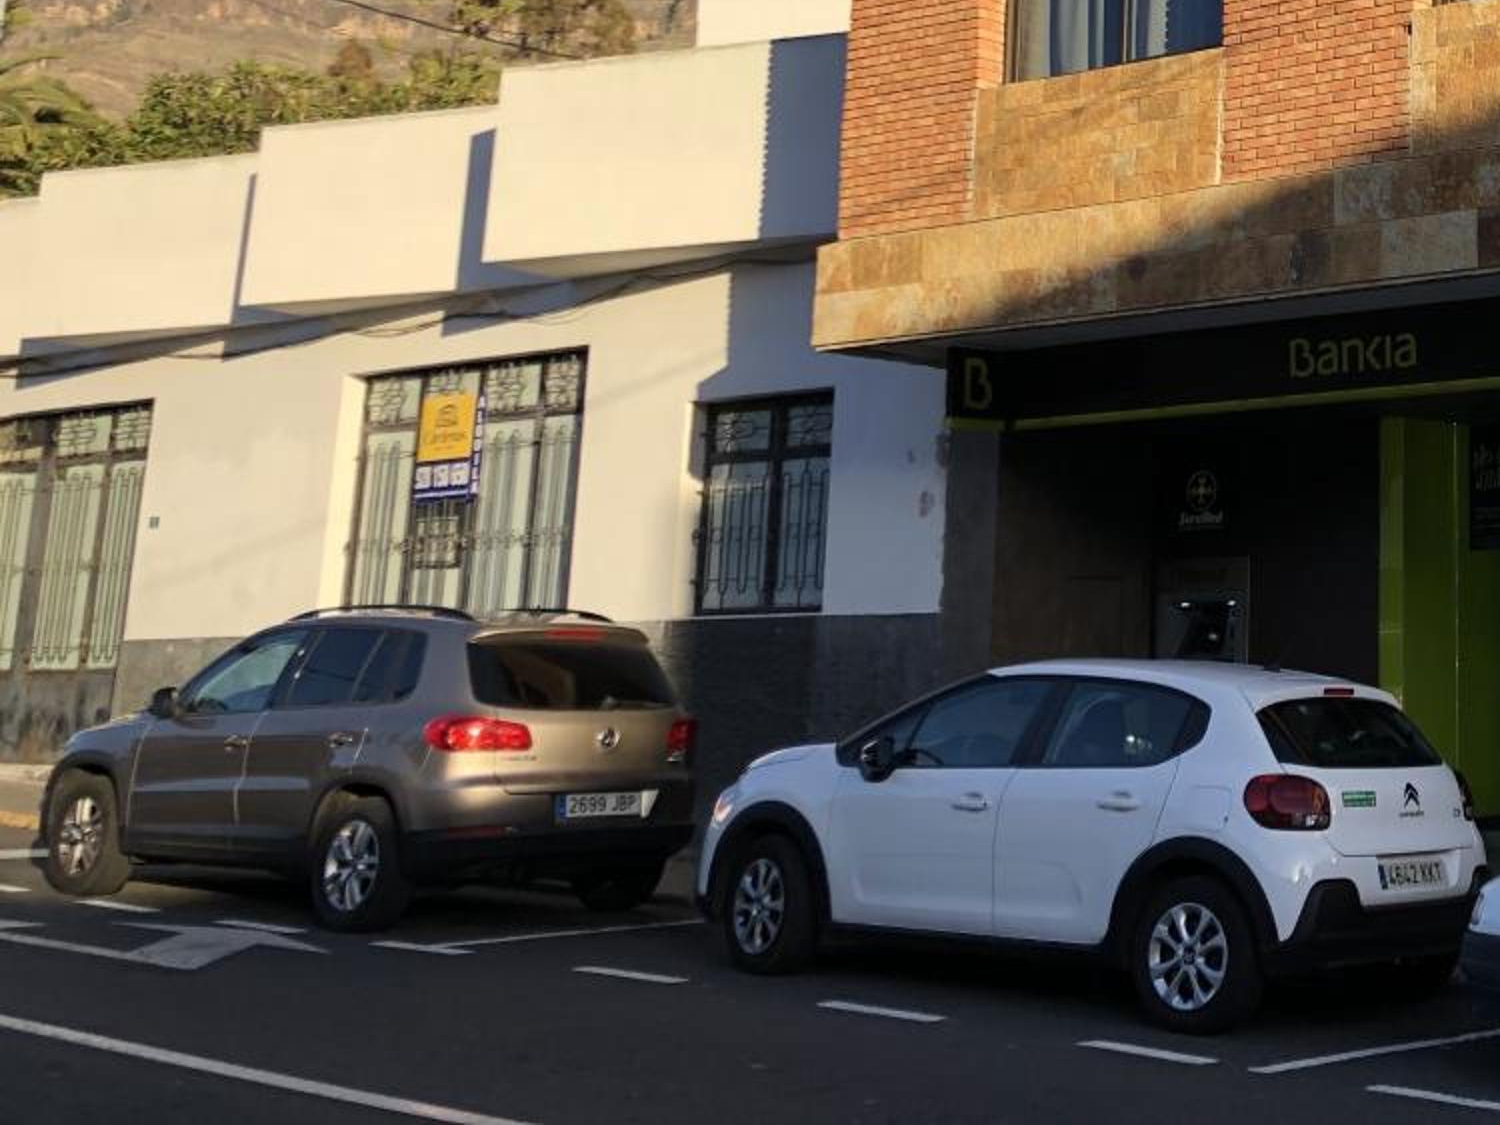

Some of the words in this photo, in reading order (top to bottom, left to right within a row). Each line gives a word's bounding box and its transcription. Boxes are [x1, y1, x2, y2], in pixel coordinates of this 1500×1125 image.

[1289, 332, 1418, 377] Bankia
[963, 357, 993, 410] B
[568, 795, 607, 815] 2699
